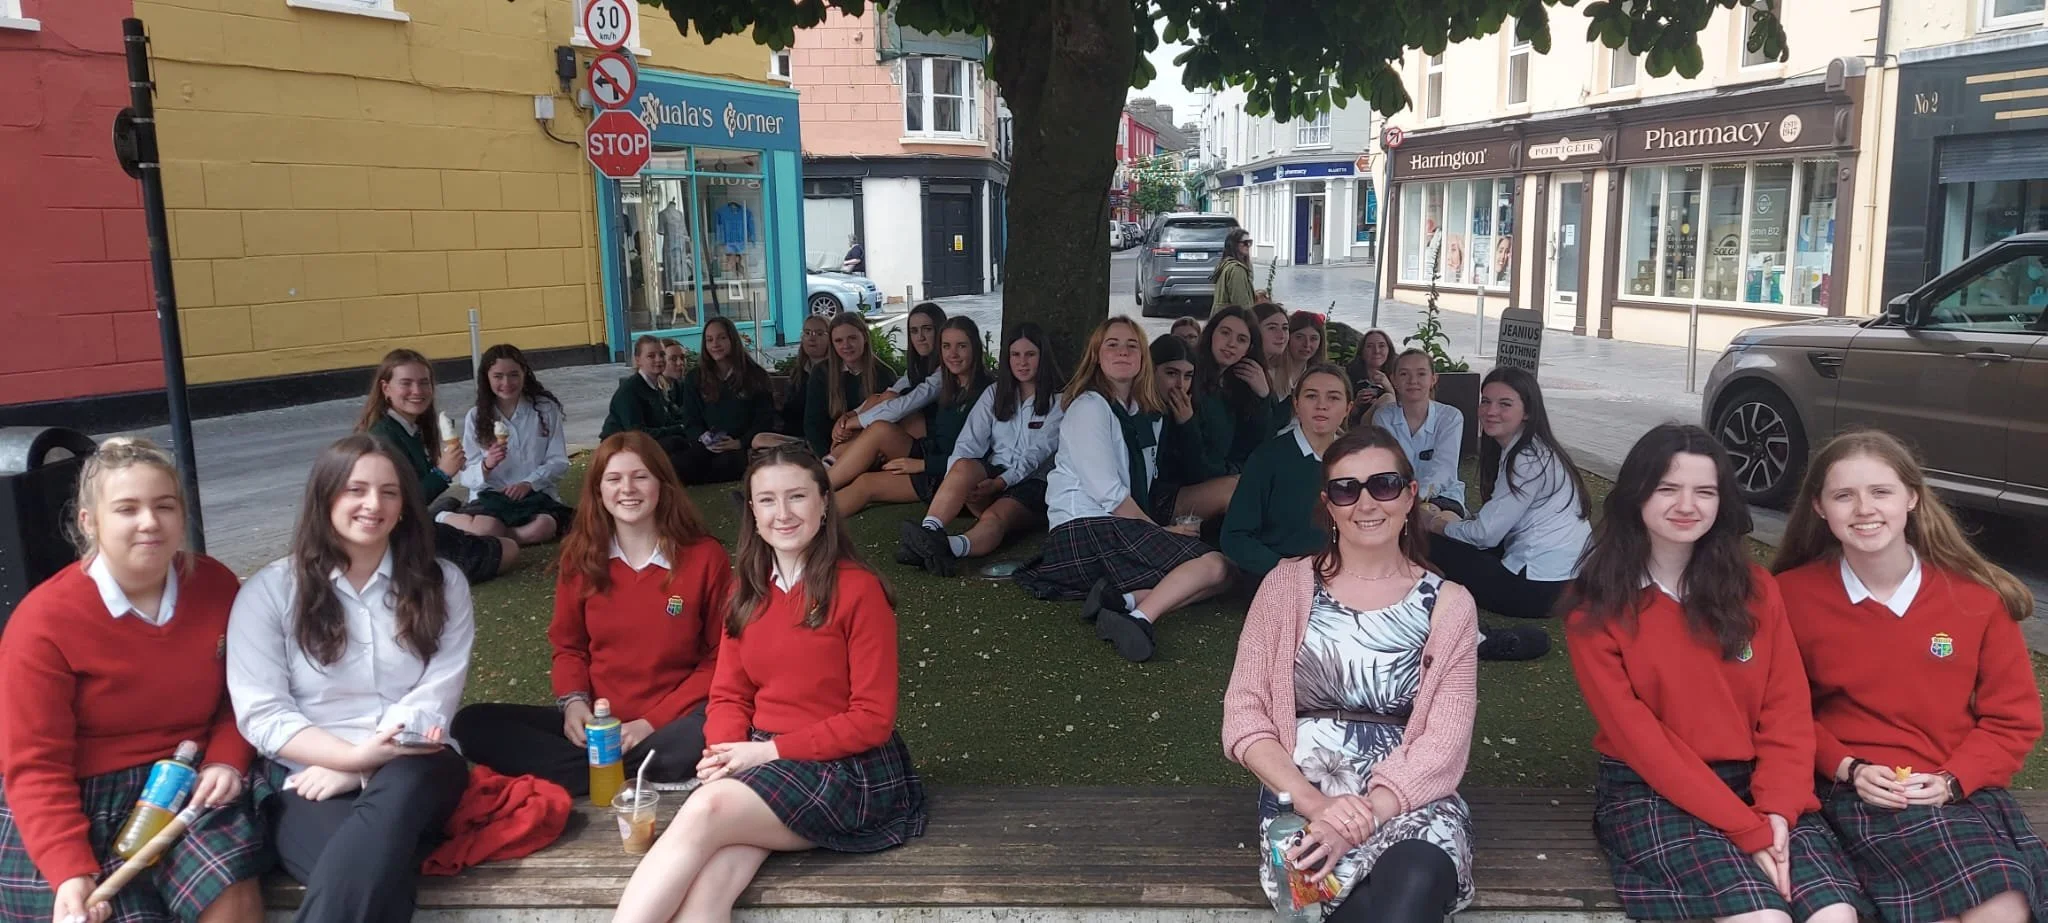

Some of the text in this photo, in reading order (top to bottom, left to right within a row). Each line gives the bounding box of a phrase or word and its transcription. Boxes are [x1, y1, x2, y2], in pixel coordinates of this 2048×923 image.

[596, 6, 619, 29] 30
[600, 32, 617, 40] km/h
[1931, 91, 1939, 113] 2
[640, 92, 784, 138] Nuala's Corner
[590, 133, 647, 156] STOP
[1644, 121, 1771, 150] Pharmacy
[1713, 247, 1740, 256] SOLGA
[1502, 324, 1539, 340] JEANIUS
[1500, 343, 1537, 358] CLOTHING
